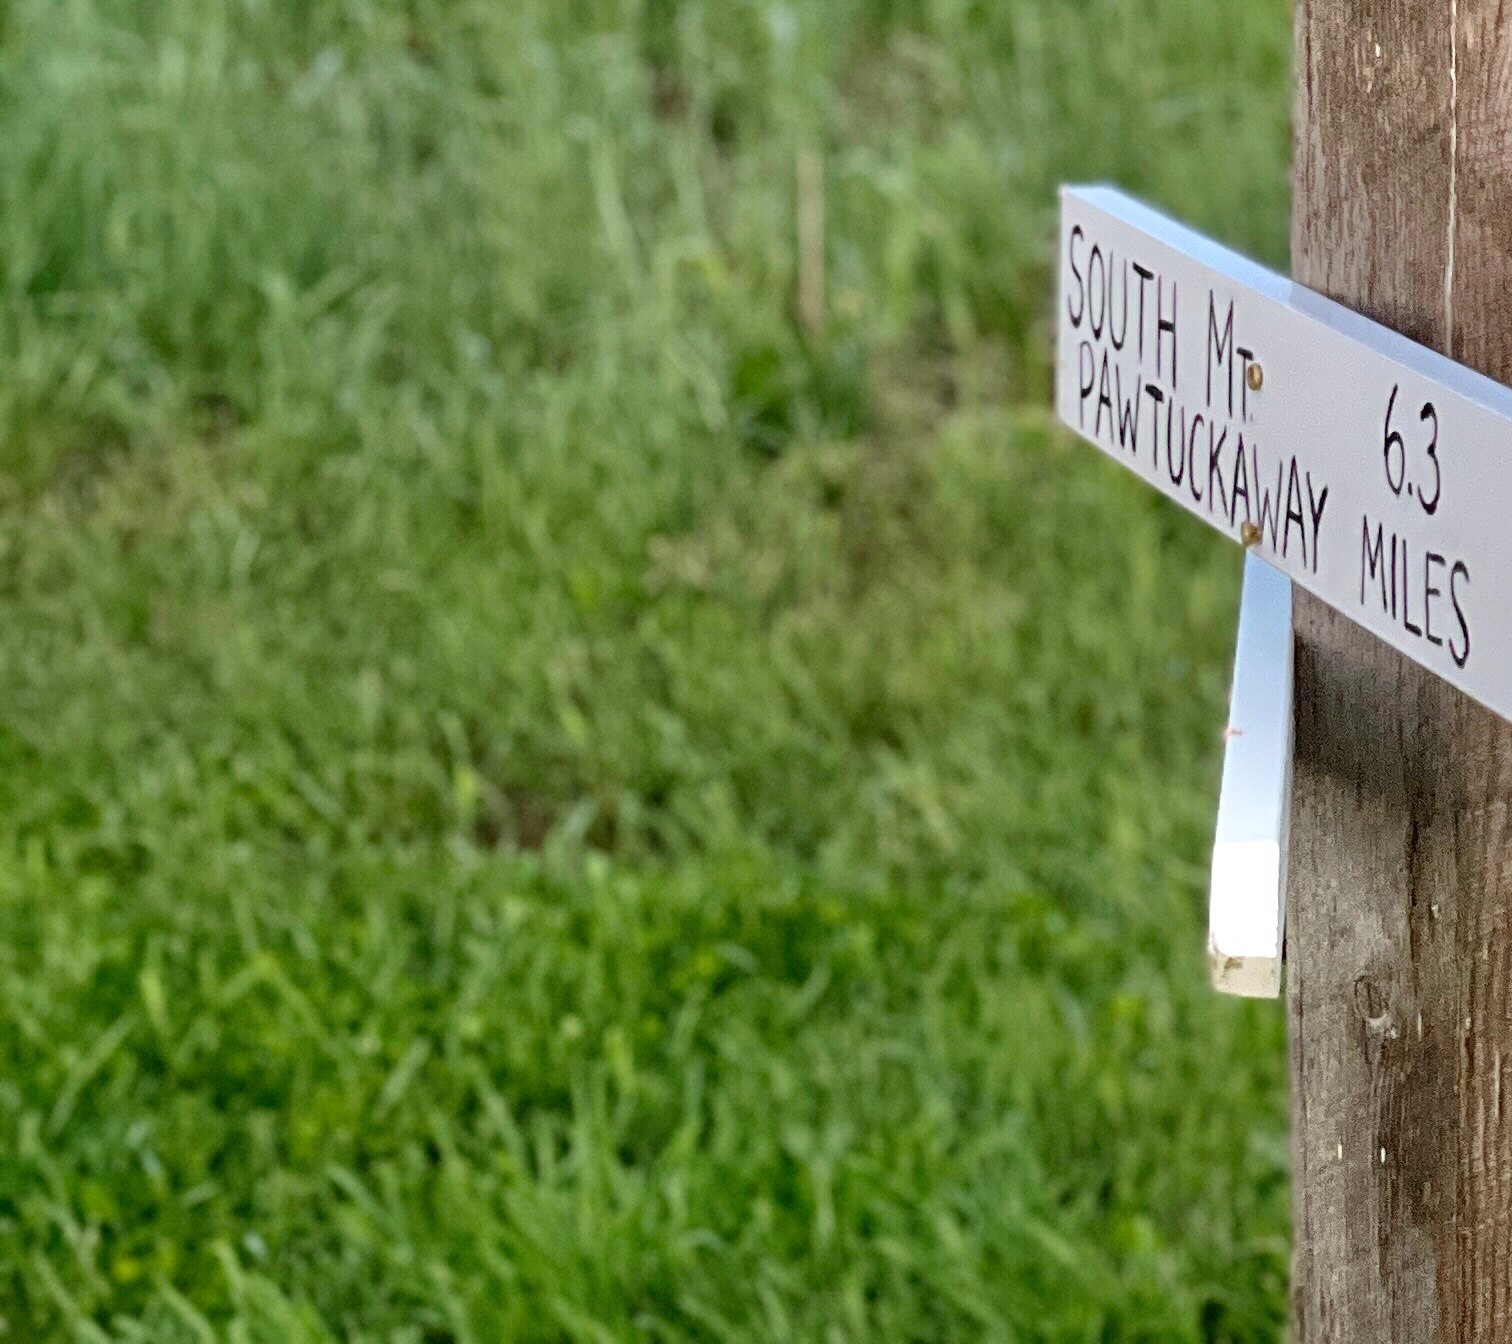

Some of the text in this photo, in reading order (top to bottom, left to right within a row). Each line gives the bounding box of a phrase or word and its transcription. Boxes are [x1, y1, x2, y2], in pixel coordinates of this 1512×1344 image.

[1067, 224, 1179, 389] SOUTH
[1079, 339, 1330, 575] PAWTUCKAWAY
[1382, 382, 1442, 517] 6.3
[1359, 512, 1472, 670] MILES
